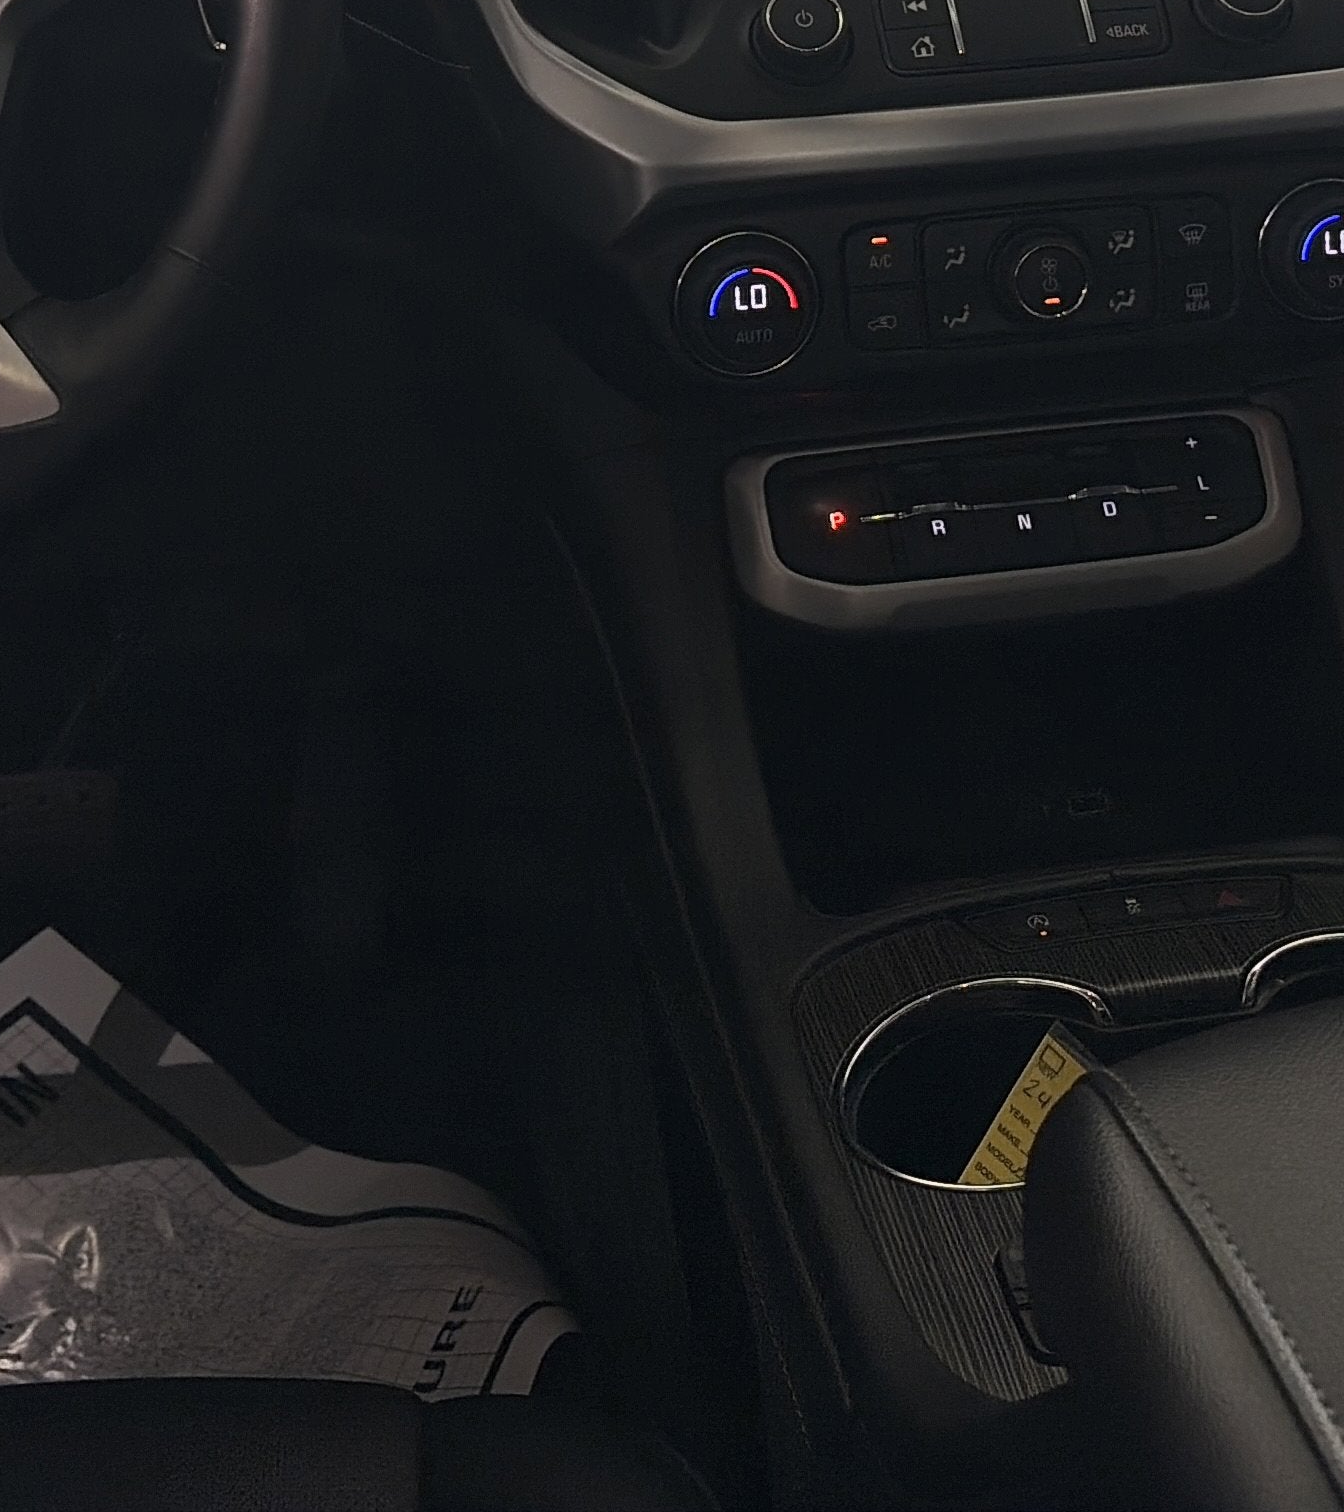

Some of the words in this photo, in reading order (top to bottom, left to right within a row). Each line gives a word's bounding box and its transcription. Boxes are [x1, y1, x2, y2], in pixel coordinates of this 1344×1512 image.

[1115, 22, 1150, 41] BACK
[869, 254, 892, 269] A/C
[734, 283, 767, 311] LO
[735, 328, 773, 344] AUTO
[1196, 475, 1211, 492] L
[1102, 500, 1117, 518] D
[828, 510, 847, 531] P
[931, 518, 947, 537] R
[1017, 512, 1033, 531] N
[1009, 1104, 1031, 1128] YEAR
[997, 1123, 1021, 1146] MAKE
[986, 1142, 1016, 1173] MODEL
